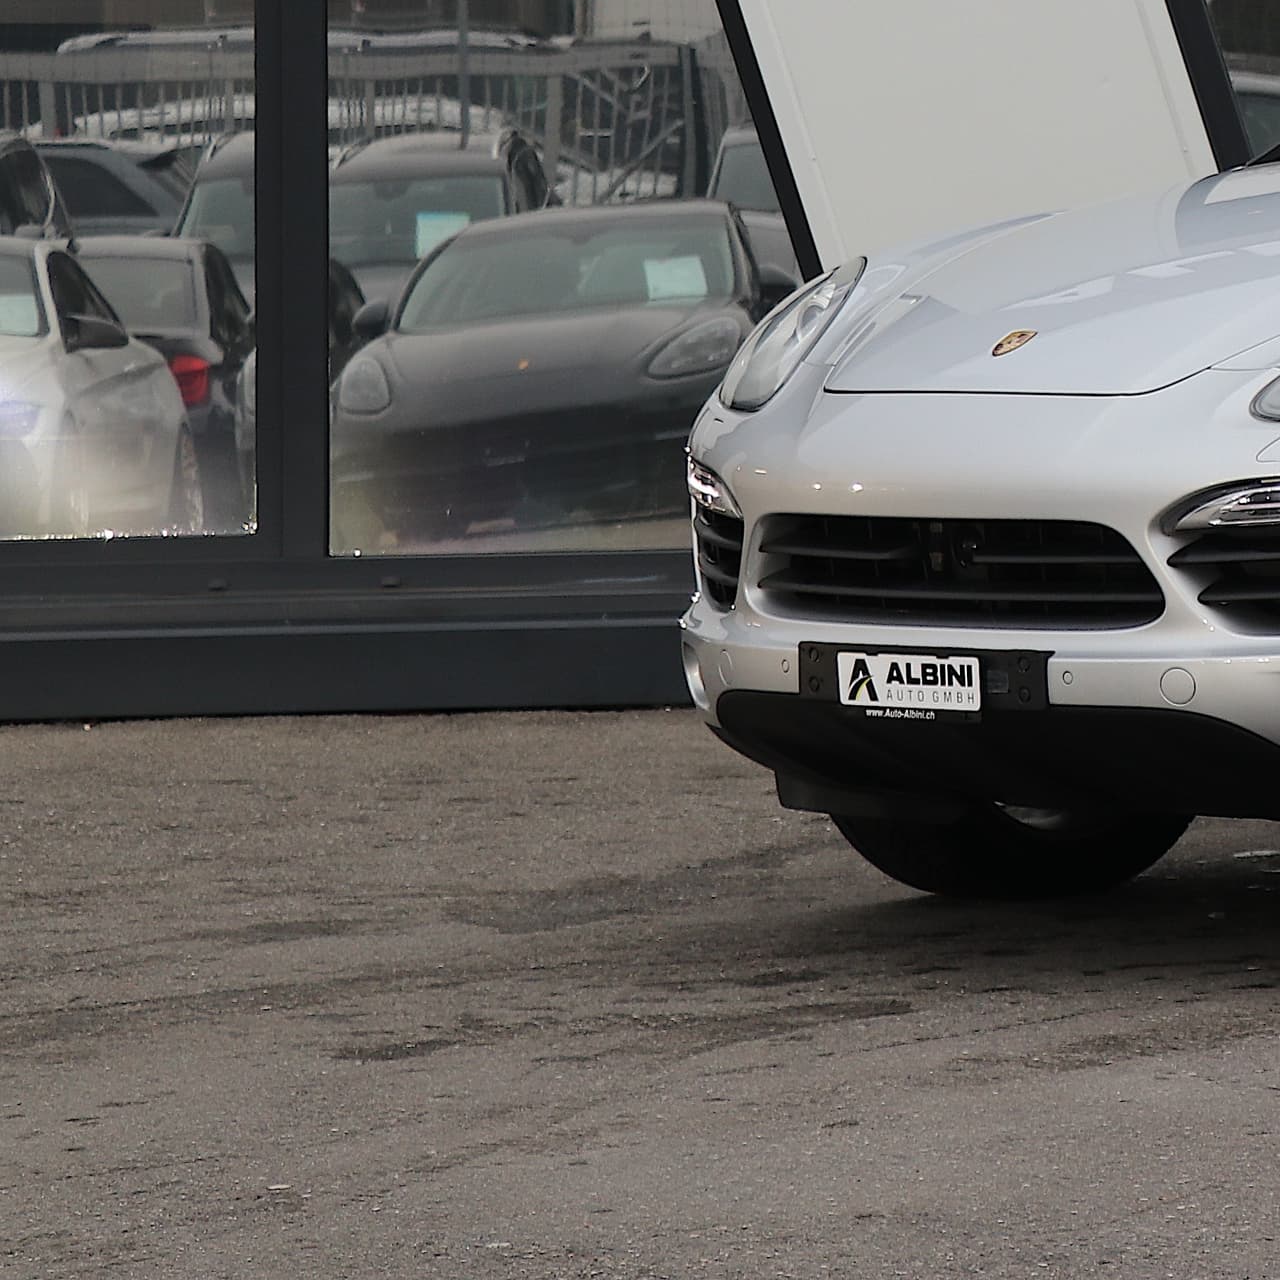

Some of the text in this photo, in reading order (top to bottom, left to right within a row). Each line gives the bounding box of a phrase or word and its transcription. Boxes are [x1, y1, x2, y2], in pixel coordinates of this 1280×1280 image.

[886, 661, 973, 687] ALBINI
[886, 689, 974, 703] AUTO GMBH
[865, 708, 935, 720] www.Auto-Albini.ch
